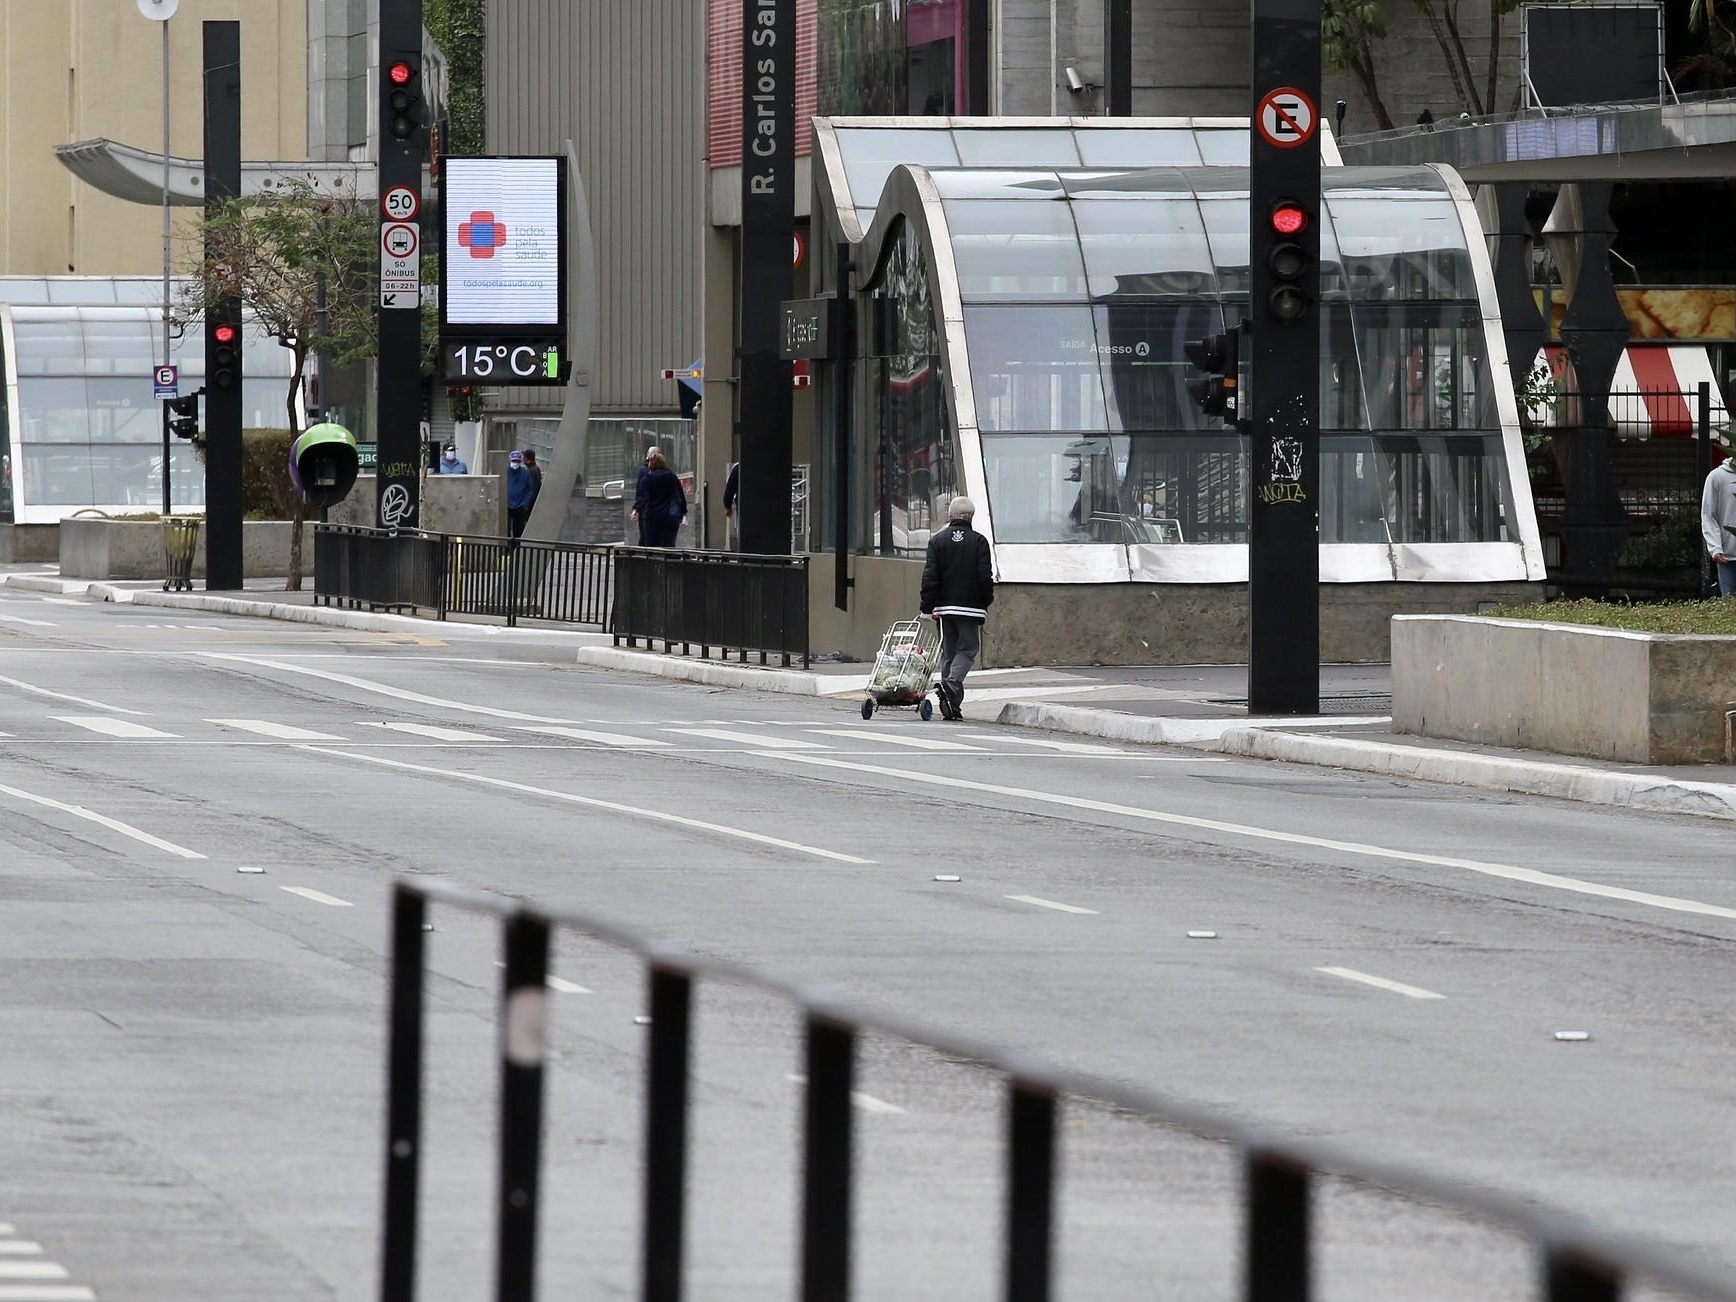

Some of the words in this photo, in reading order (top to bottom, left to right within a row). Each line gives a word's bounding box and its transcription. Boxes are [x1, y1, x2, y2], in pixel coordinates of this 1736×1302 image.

[752, 58, 776, 157] Carlos
[751, 167, 775, 194] R.
[389, 194, 413, 209] 50
[515, 225, 545, 237] todos
[515, 238, 538, 250] pela
[384, 268, 416, 277] ÔNIBUS
[1089, 343, 1132, 354] Acesso
[454, 345, 537, 377] 15°C
[160, 370, 171, 383] E
